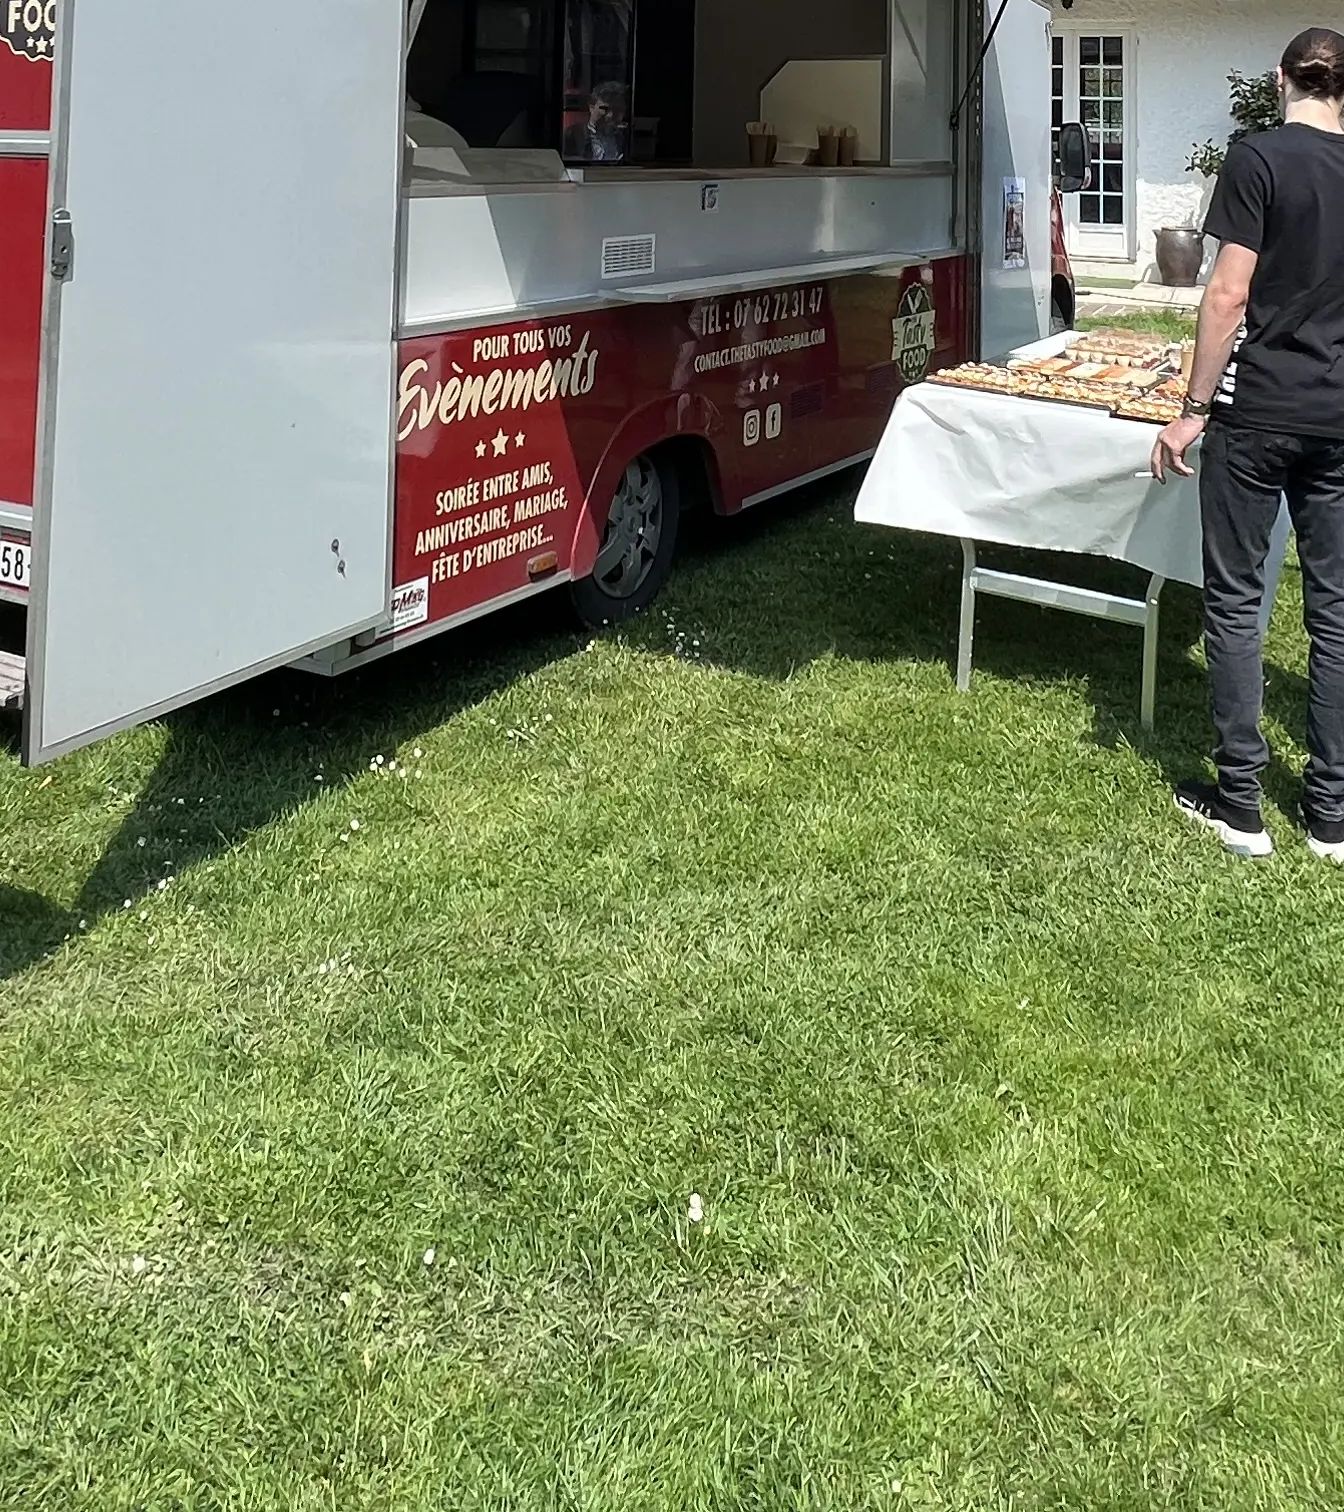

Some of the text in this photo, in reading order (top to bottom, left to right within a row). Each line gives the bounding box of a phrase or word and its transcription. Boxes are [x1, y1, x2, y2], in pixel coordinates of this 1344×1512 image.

[700, 297, 722, 336] TÉL
[733, 298, 751, 329] 07
[753, 294, 769, 325] 62
[772, 292, 789, 322] 72
[791, 289, 805, 318] 31
[808, 286, 824, 315] 47
[902, 314, 927, 349] Tasty
[472, 324, 572, 363] POUR TOUS VOS
[694, 327, 826, 373] CONTACT.THETASTYFOOD@GMAIL.COM
[902, 347, 927, 372] FOOD
[396, 330, 599, 442] Evènements
[435, 461, 554, 516] SOIRÉE ENTRE AMIS,
[414, 486, 569, 556] ANNIVERSAIRE, MARIAGE,
[431, 523, 554, 584] FÊTE D'ENTREPRISE...
